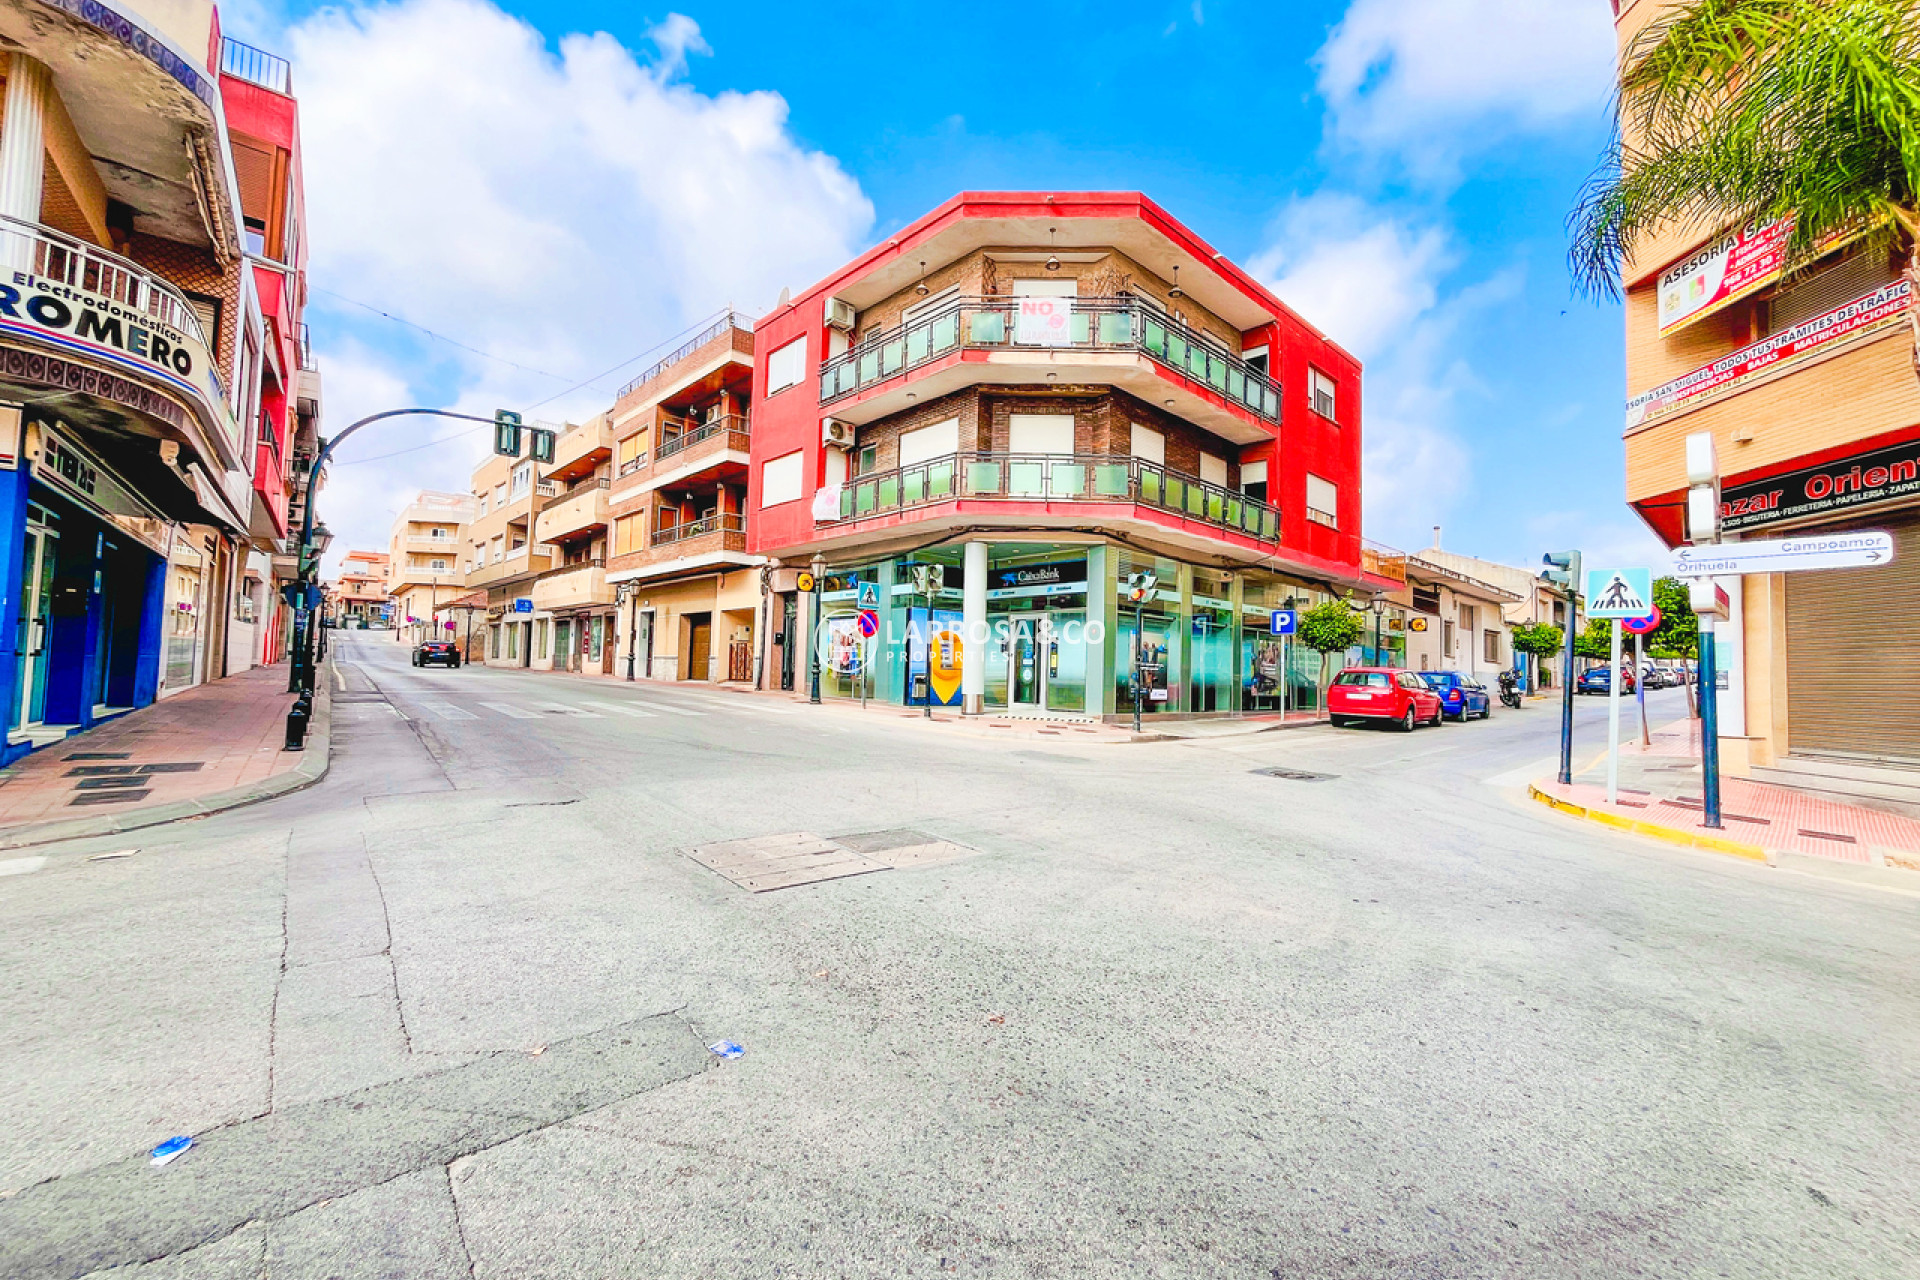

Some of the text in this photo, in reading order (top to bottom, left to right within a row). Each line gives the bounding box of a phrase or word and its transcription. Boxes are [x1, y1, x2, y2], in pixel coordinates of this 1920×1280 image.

[1663, 236, 1736, 287] ASESORIA
[1022, 300, 1054, 316] NO
[0, 284, 192, 376] ROMERO
[1714, 351, 1749, 373] TODOS
[1752, 343, 1771, 358] TUS
[1837, 306, 1855, 321] DE
[1747, 351, 1780, 371] BAJAS
[1793, 296, 1911, 353] MATRICULACIONES
[1719, 489, 1784, 518] azar
[1783, 500, 1834, 516] FERRETERIA
[1835, 488, 1885, 506] PAPELERIA
[1781, 536, 1883, 553] Campoamor
[1677, 560, 1738, 573] Orihuela
[1276, 612, 1291, 632] P
